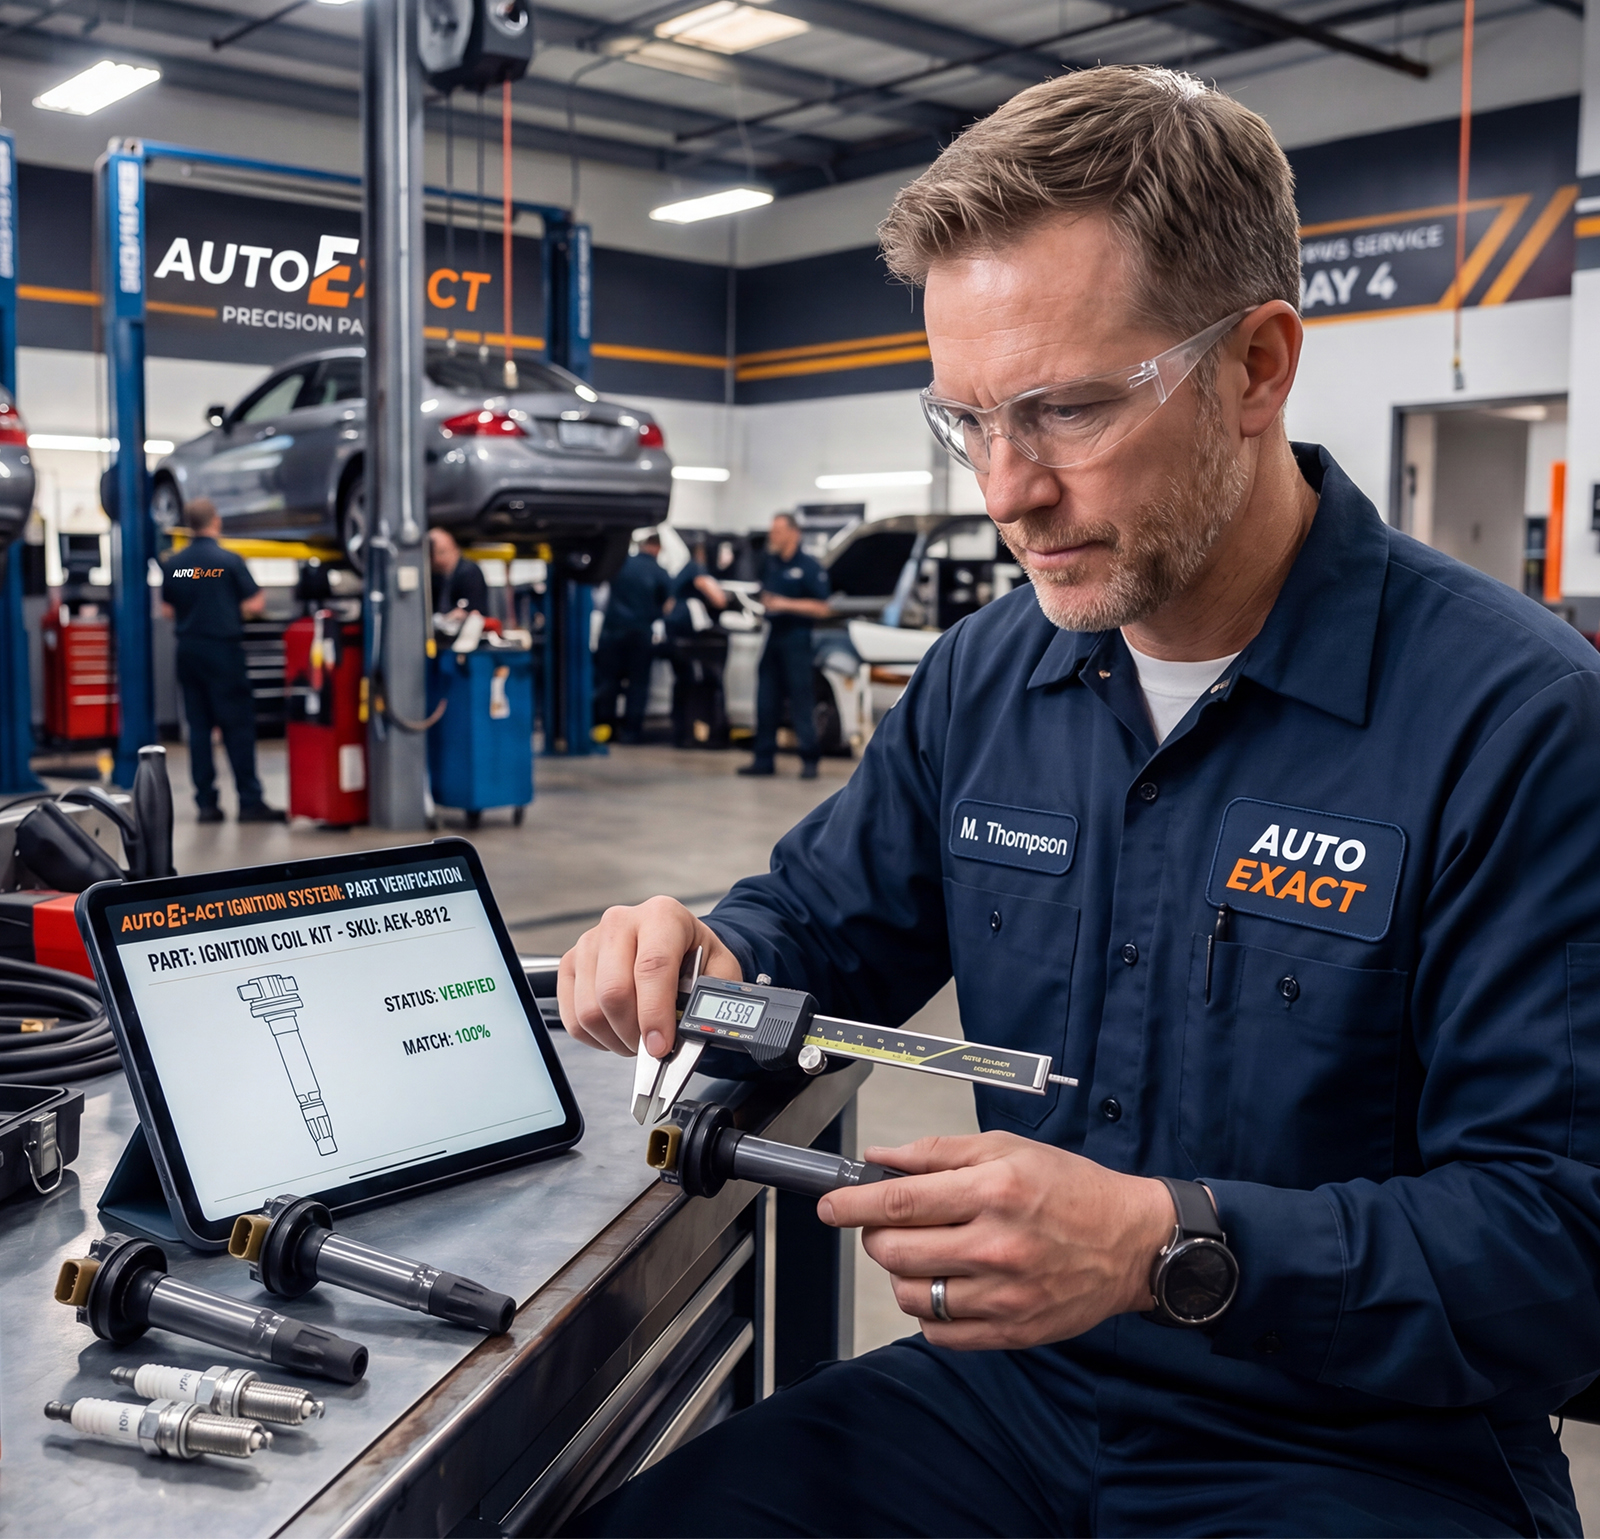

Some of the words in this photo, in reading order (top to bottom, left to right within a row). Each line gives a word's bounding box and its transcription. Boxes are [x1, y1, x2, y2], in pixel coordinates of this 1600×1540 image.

[1352, 224, 1445, 258] SERVICE
[153, 234, 491, 312] AUTOECT
[1299, 265, 1361, 309] AY
[1366, 261, 1398, 300] 4
[222, 305, 332, 333] PRECISION
[960, 816, 979, 841] M.
[986, 821, 1068, 856] Thompson
[1249, 823, 1367, 872] AUTO
[226, 892, 287, 916] IGNITION
[287, 884, 346, 907] SYSTEM:
[345, 878, 380, 899] PART
[1225, 857, 1368, 913] EXACT
[148, 947, 197, 973] PART:
[198, 935, 268, 964] IGNITION
[271, 929, 308, 951] COIL
[308, 925, 334, 945] KIT
[345, 917, 382, 939] SKU:
[383, 906, 452, 932] AEK-8812
[384, 989, 439, 1013] STATUS:
[438, 977, 496, 1001] VERIFIED
[402, 1032, 454, 1056] MATCH:
[454, 1024, 491, 1044] 100%
